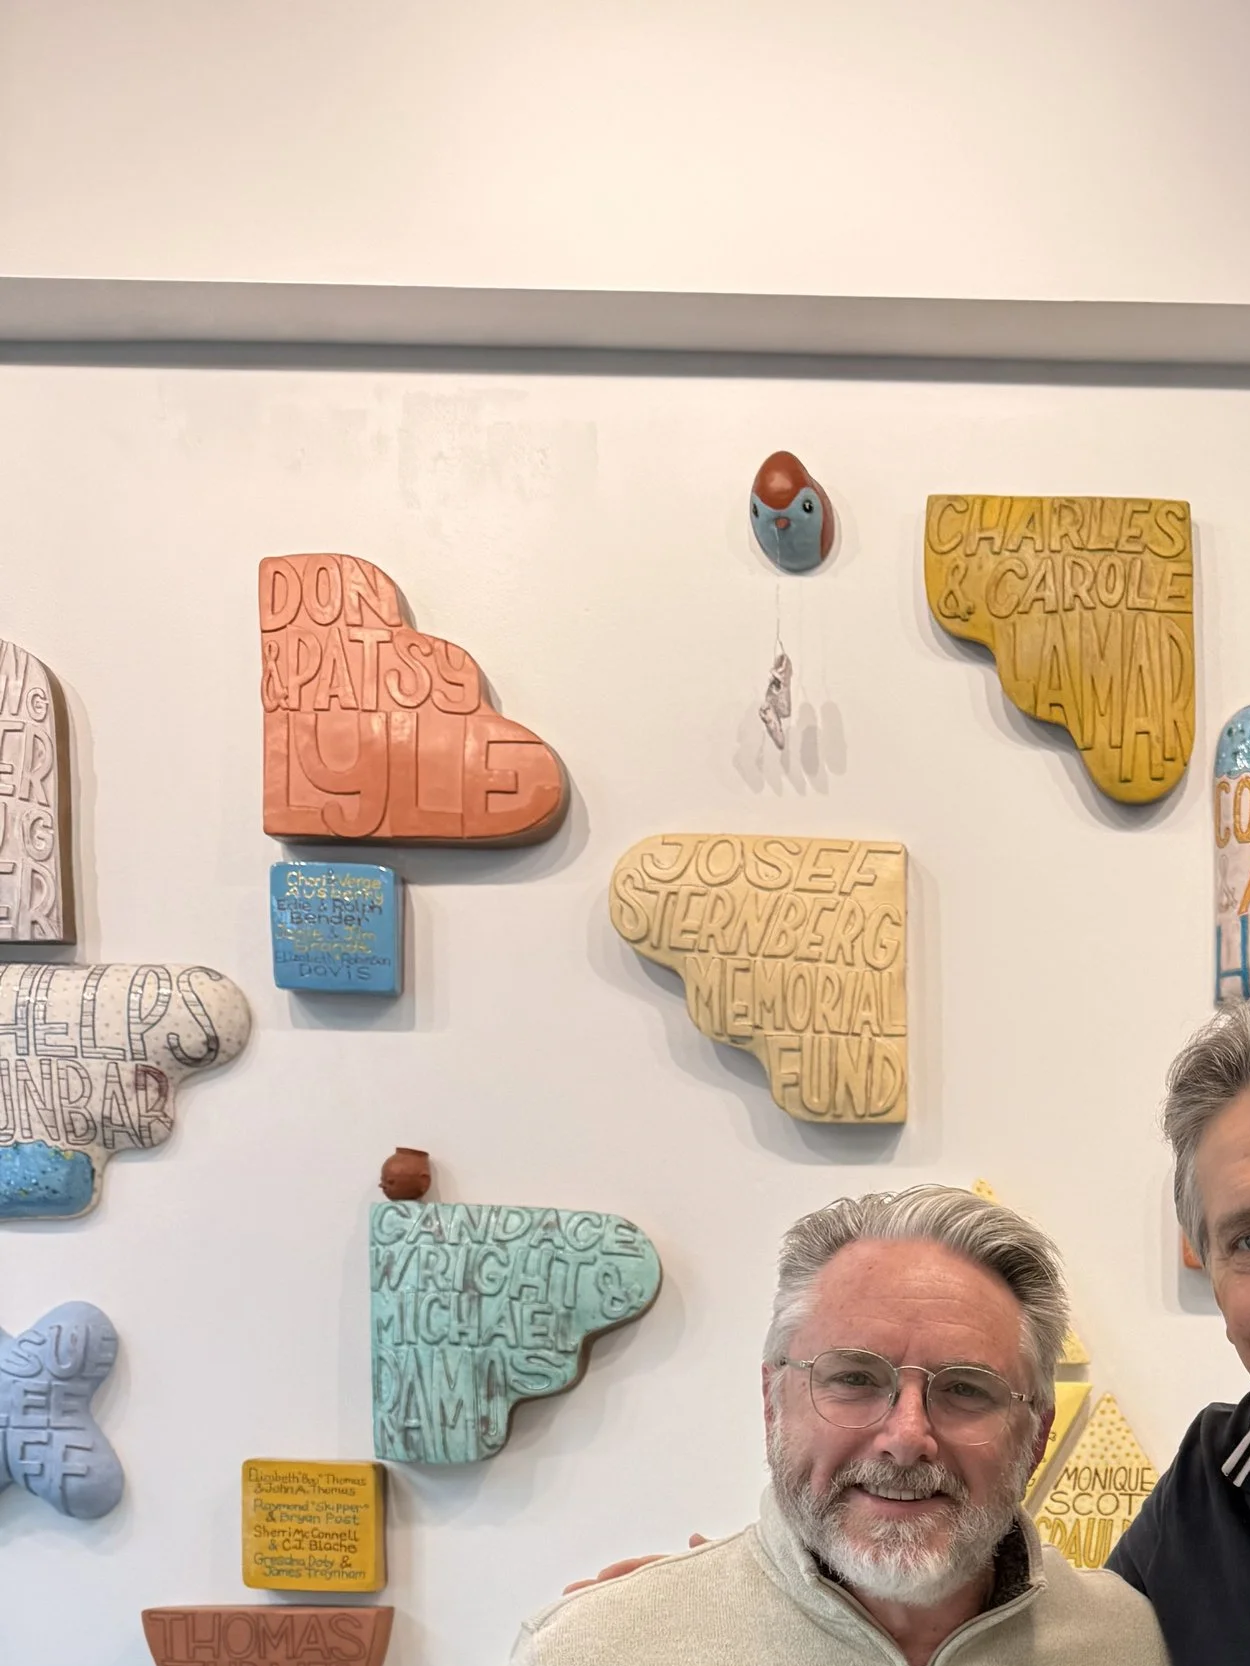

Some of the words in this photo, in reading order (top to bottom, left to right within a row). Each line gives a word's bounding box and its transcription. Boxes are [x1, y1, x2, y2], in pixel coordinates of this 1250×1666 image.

[927, 495, 1190, 558] CHARLES
[259, 554, 402, 632] DON
[938, 561, 974, 621] &
[986, 554, 1192, 618] CAROLE
[262, 640, 288, 712] &
[288, 625, 480, 715] PATSY
[993, 610, 1195, 783] LAMAR
[264, 711, 561, 838] LYLE
[641, 834, 902, 895] JOSEF
[610, 868, 902, 971] STERNBERG
[684, 957, 907, 1044] MEMORIAL
[764, 1034, 904, 1118] FUND
[373, 1203, 644, 1257] CANDACE
[372, 1244, 595, 1310] WRIGHT
[597, 1262, 644, 1319] &
[376, 1291, 578, 1353] MICHAEL
[374, 1345, 570, 1460] RAMOS
[311, 1484, 356, 1496] Thomas
[325, 1473, 367, 1486] Thomas
[1045, 1491, 1148, 1516] SCOT
[1054, 1466, 1157, 1492] MONIQUE
[254, 1525, 292, 1538] Sherri
[266, 1512, 276, 1523] &
[280, 1513, 321, 1524] Bryan
[325, 1512, 360, 1526] Post
[340, 1556, 352, 1568] &
[150, 1612, 366, 1662] THOMAS
